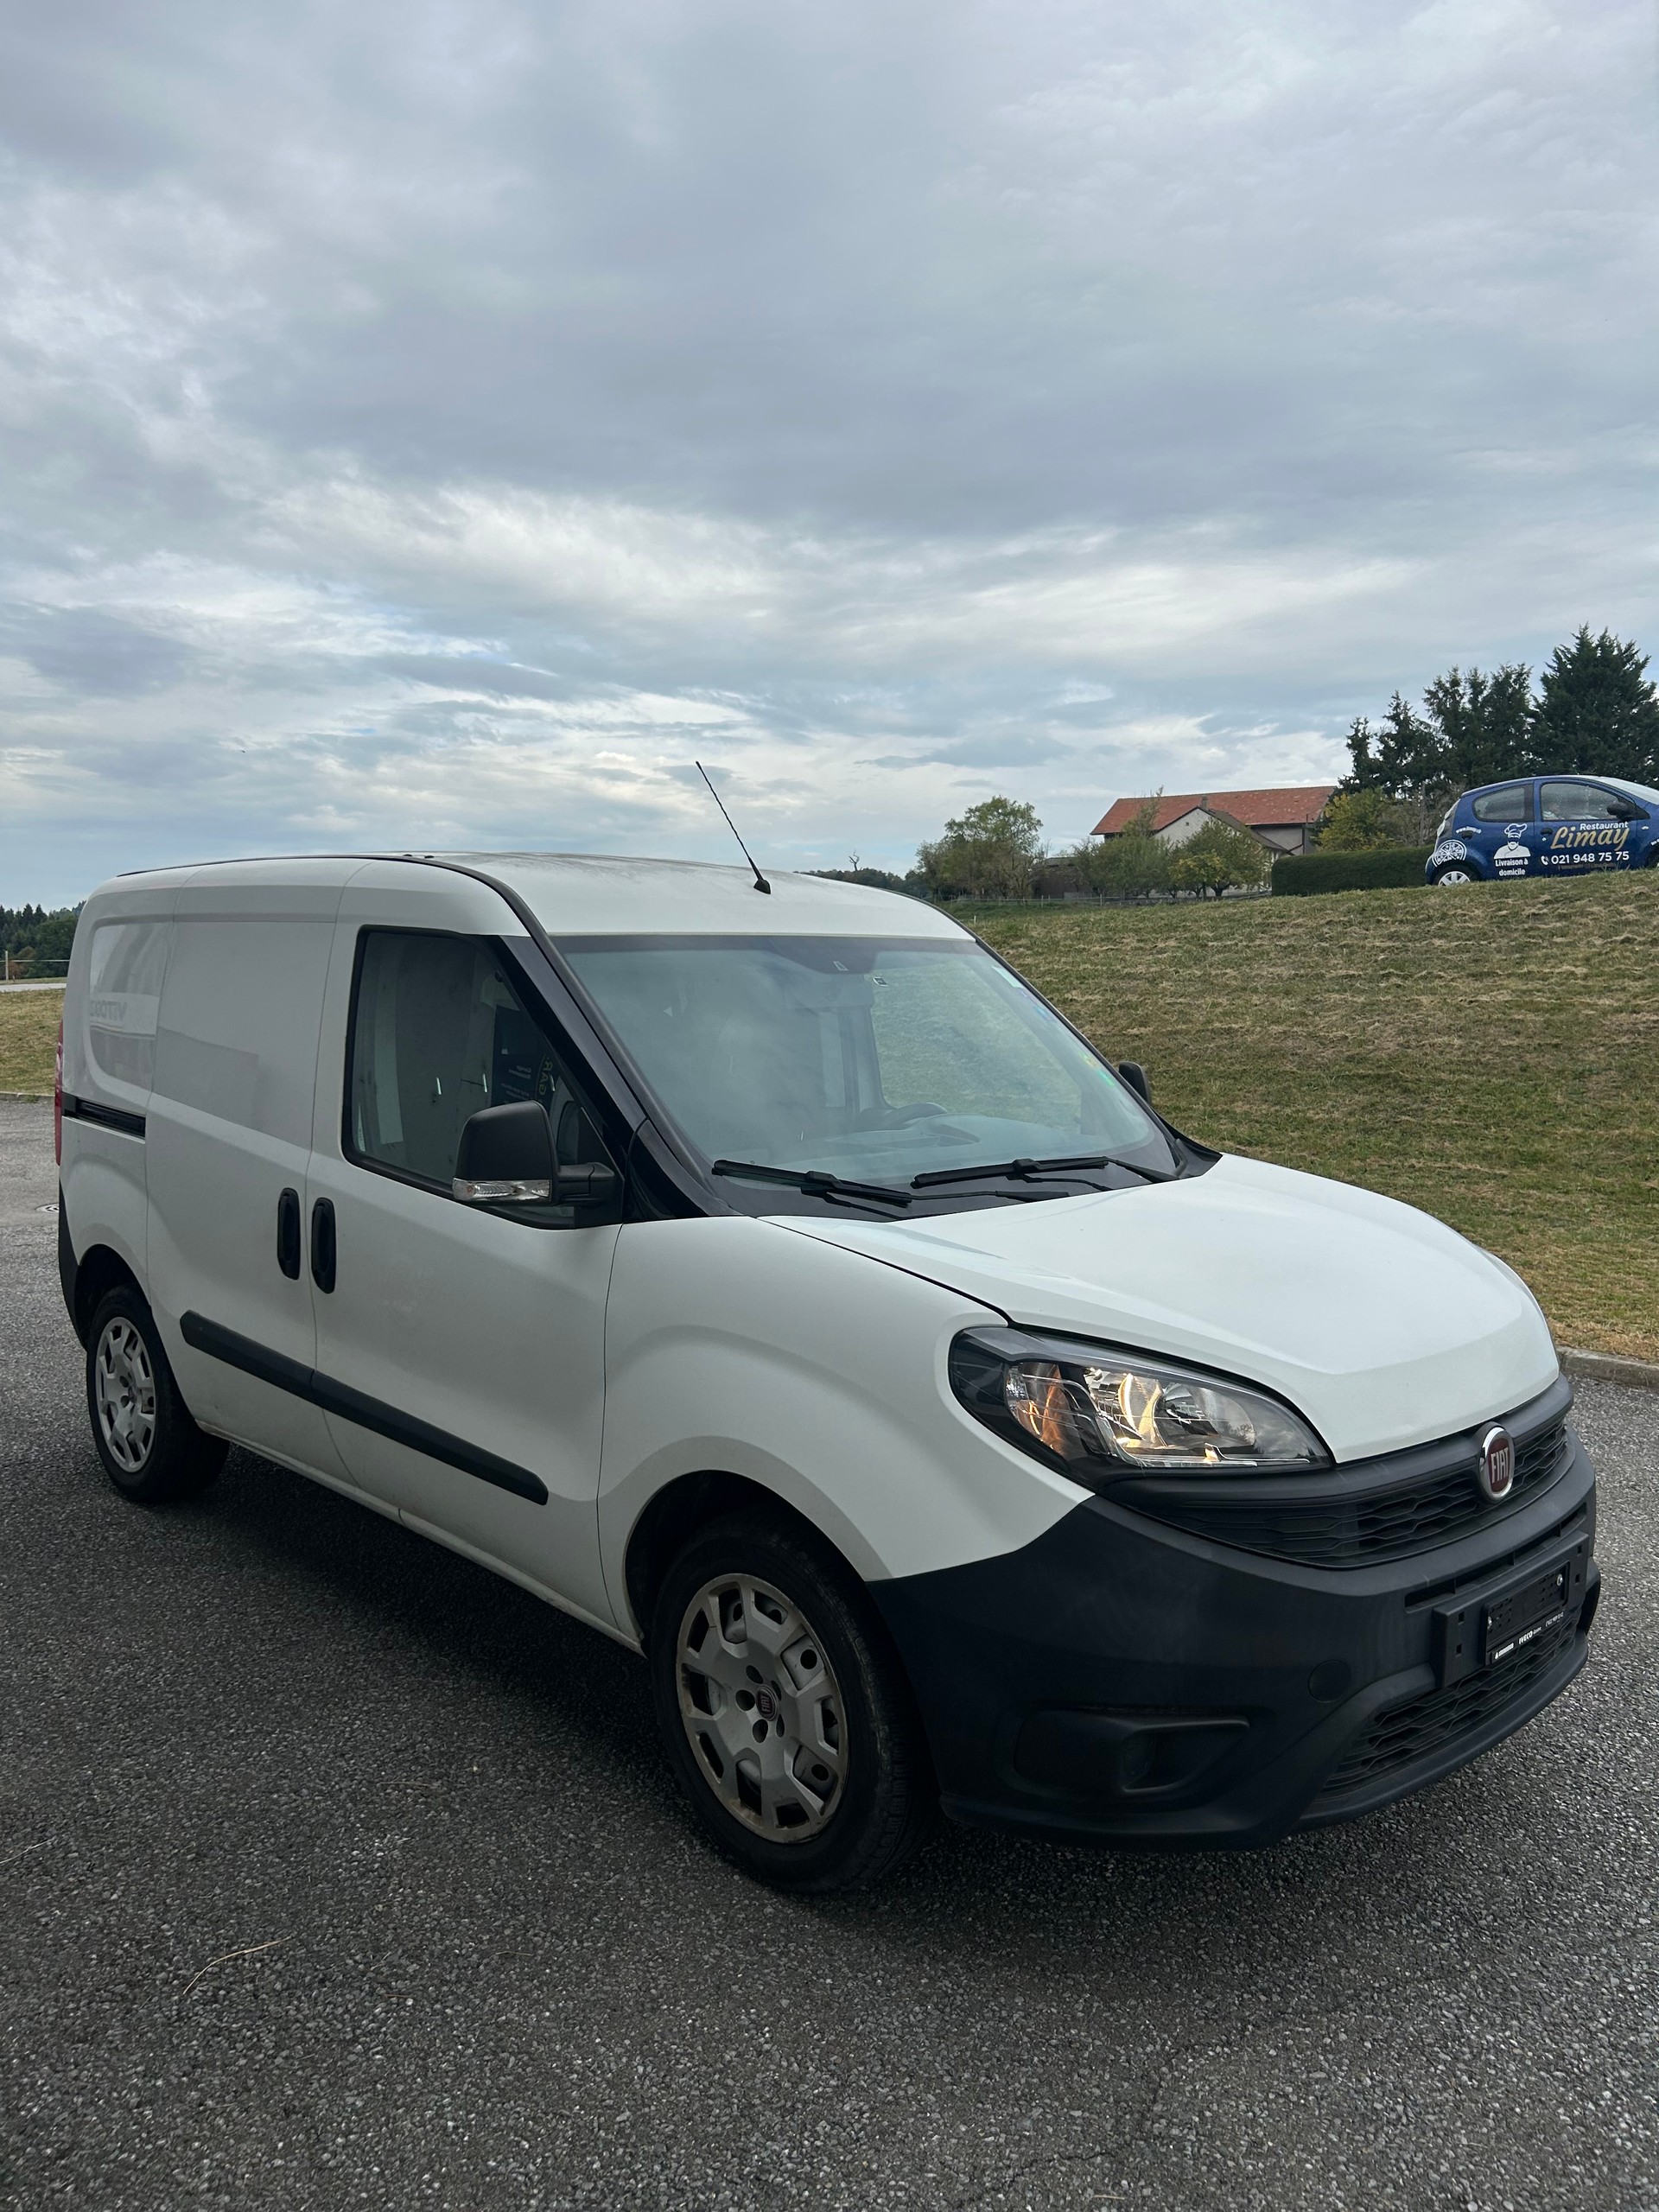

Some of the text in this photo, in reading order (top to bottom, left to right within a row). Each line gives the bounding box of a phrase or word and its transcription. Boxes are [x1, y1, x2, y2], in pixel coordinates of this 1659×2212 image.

[1580, 821, 1629, 830] Restaurant
[1550, 826, 1630, 851] Limay
[1551, 851, 1630, 865] 021 948 75 75
[1499, 868, 1526, 876] domicile
[1490, 1446, 1510, 1484] FIAT
[760, 1695, 772, 1713] FIAT
